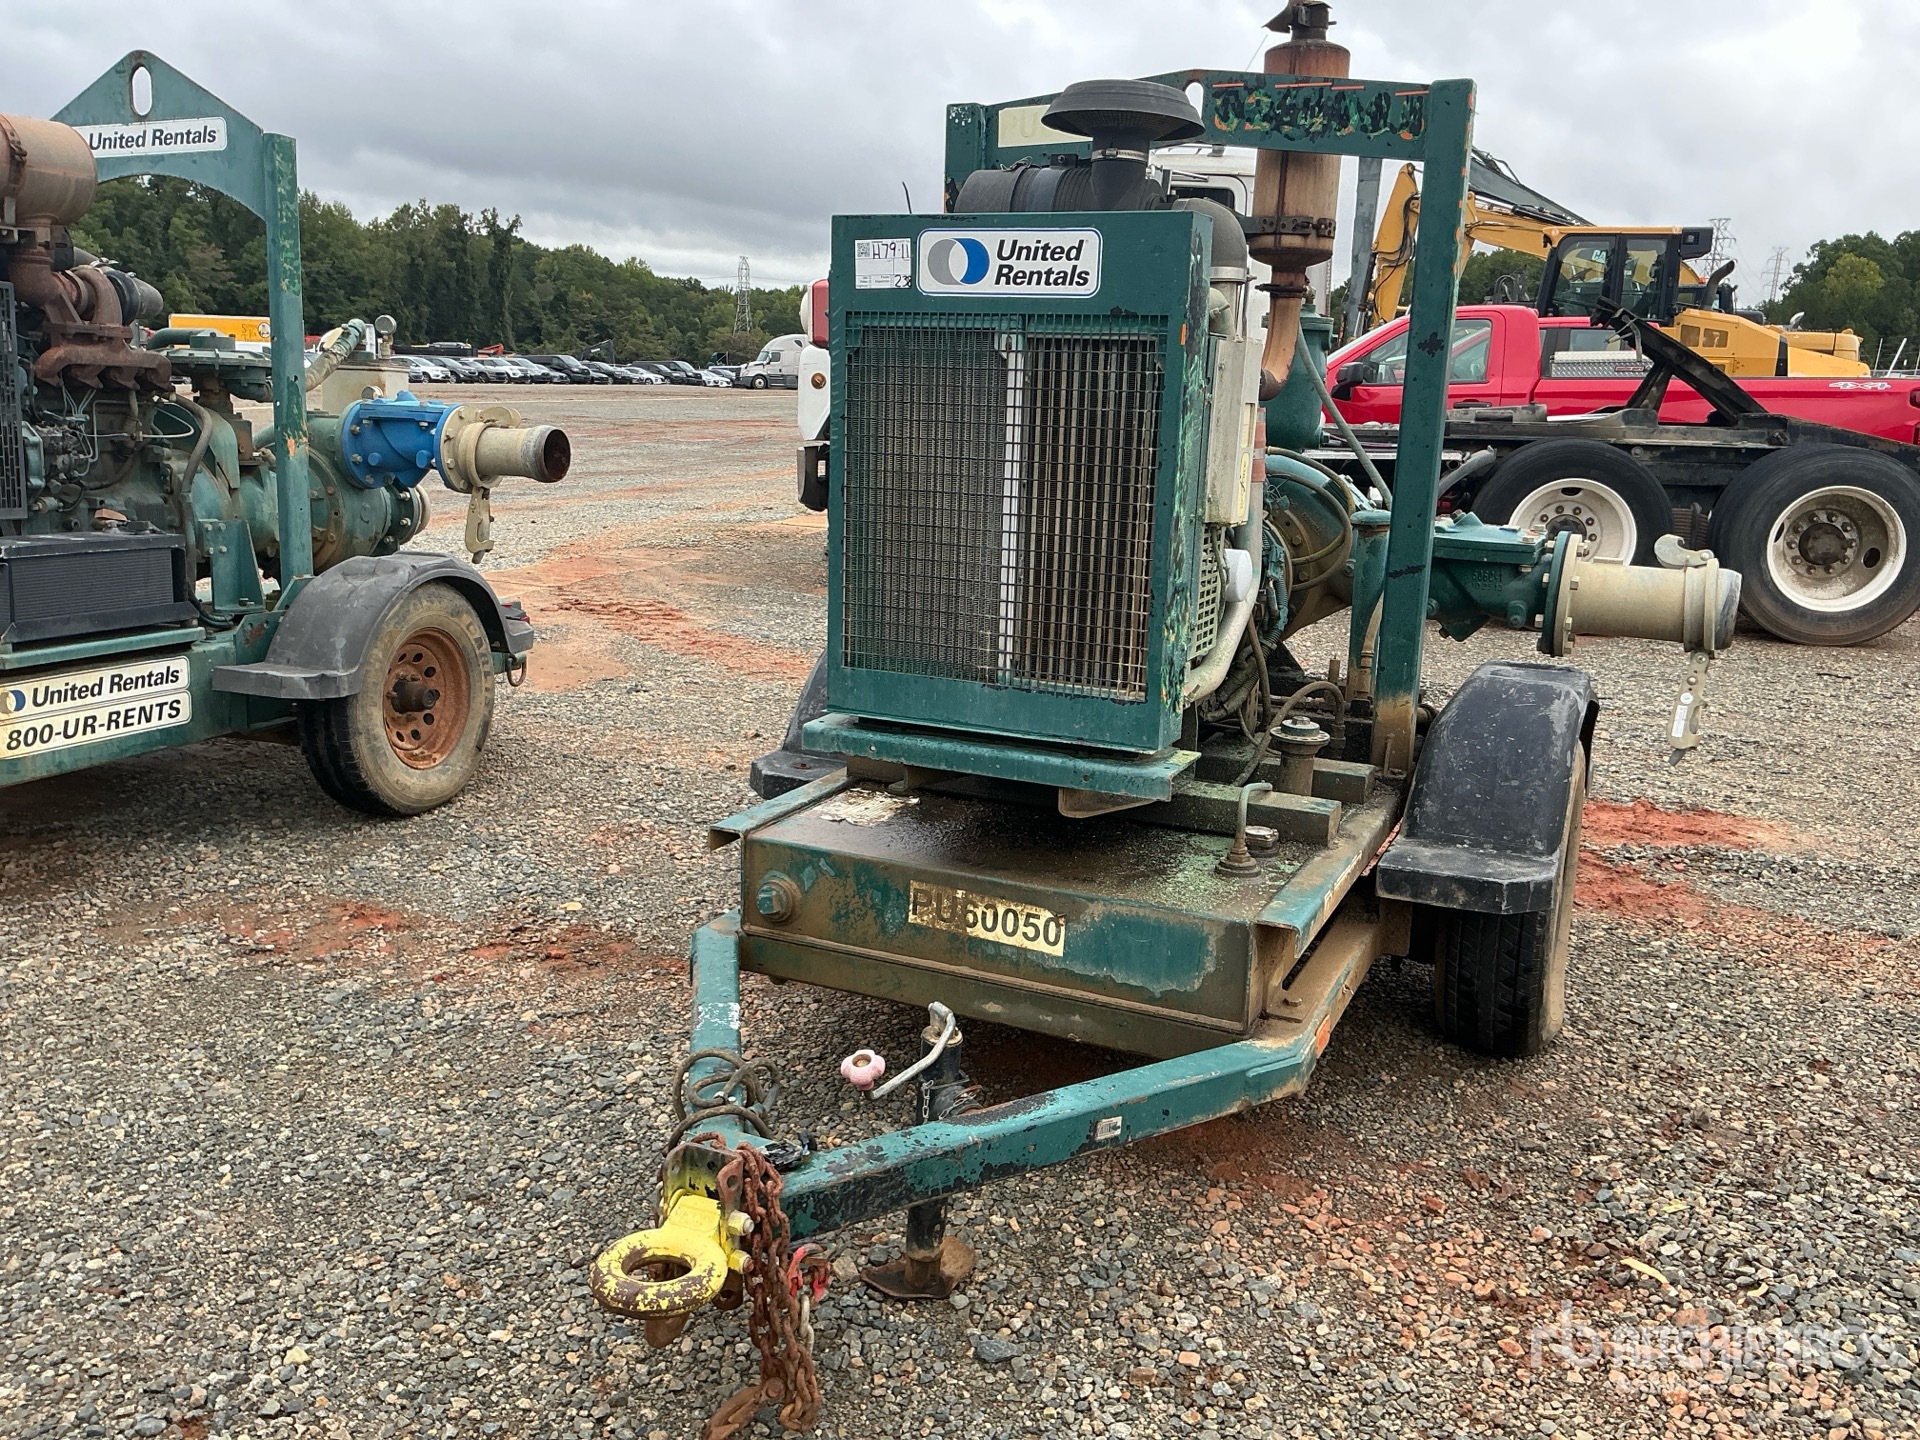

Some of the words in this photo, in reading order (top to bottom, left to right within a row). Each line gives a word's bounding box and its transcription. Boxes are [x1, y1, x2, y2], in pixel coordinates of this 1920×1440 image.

[89, 129, 147, 150] United
[151, 125, 217, 147] Rentals
[996, 239, 1085, 261] United
[994, 263, 1090, 287] Rentals
[32, 676, 104, 707] United
[109, 665, 180, 694] Rentals
[6, 699, 182, 751] 800-UR-RENTS
[912, 888, 1062, 947] PU60050
